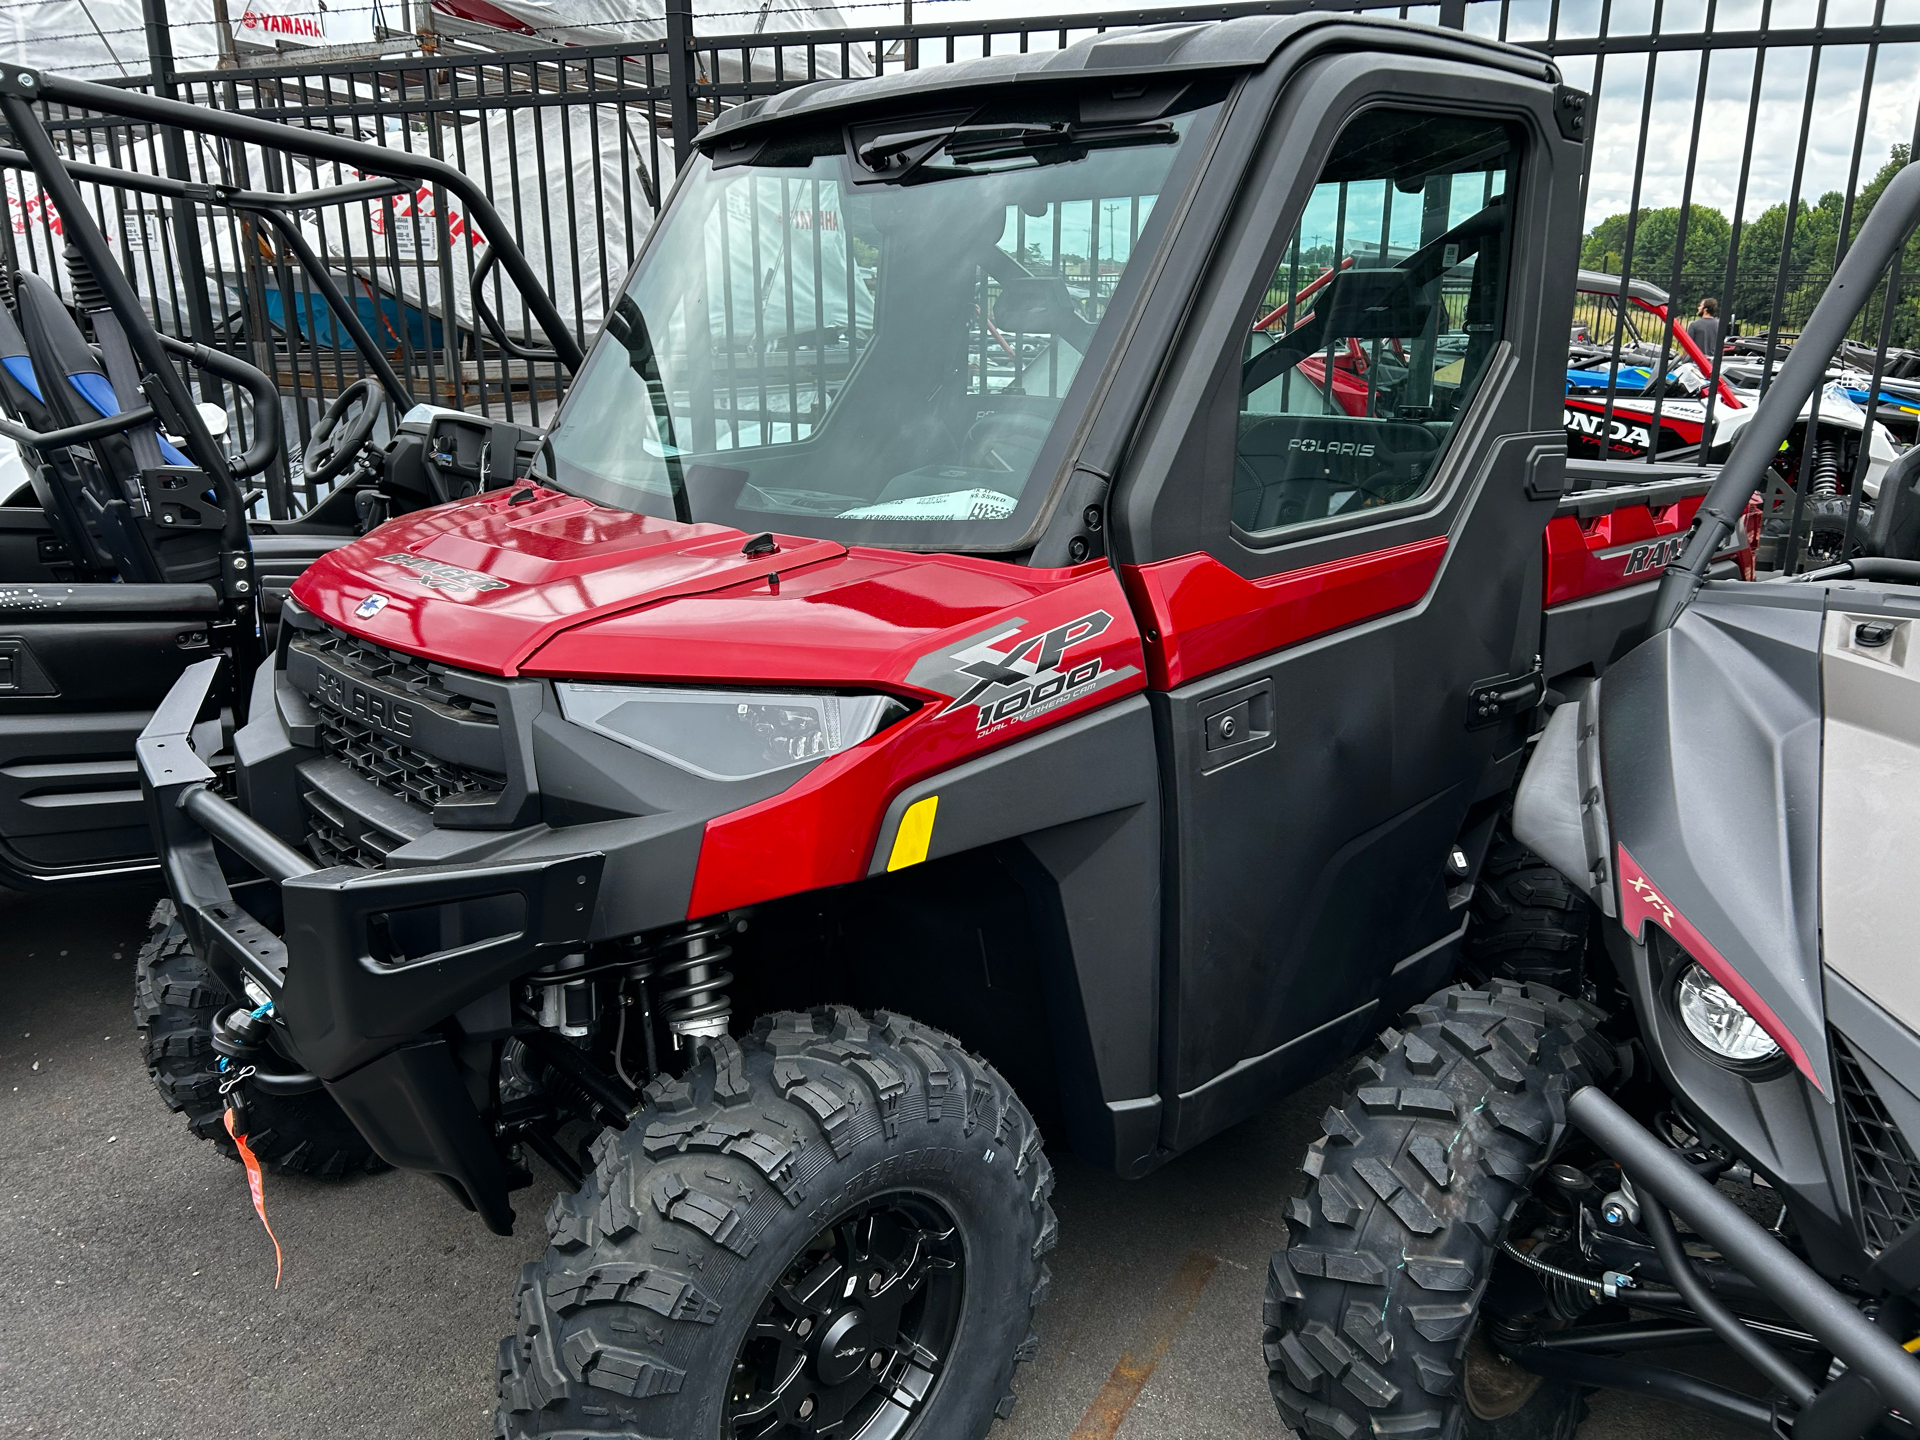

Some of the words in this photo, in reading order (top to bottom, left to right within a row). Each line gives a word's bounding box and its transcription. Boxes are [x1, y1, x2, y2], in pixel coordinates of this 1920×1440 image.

[260, 12, 322, 38] YAMAHA
[1287, 438, 1376, 457] POLARIS
[374, 553, 510, 592] RANGER
[1623, 537, 1682, 576] RAN
[399, 574, 469, 592] XP
[931, 609, 1115, 720] XP
[316, 666, 414, 738] POLARIS
[976, 657, 1102, 731] 1000
[976, 721, 1008, 739] DUAL
[1010, 693, 1072, 725] OVERHEAD
[1073, 682, 1098, 698] CAM
[807, 1146, 964, 1229] X-TERRAIN
